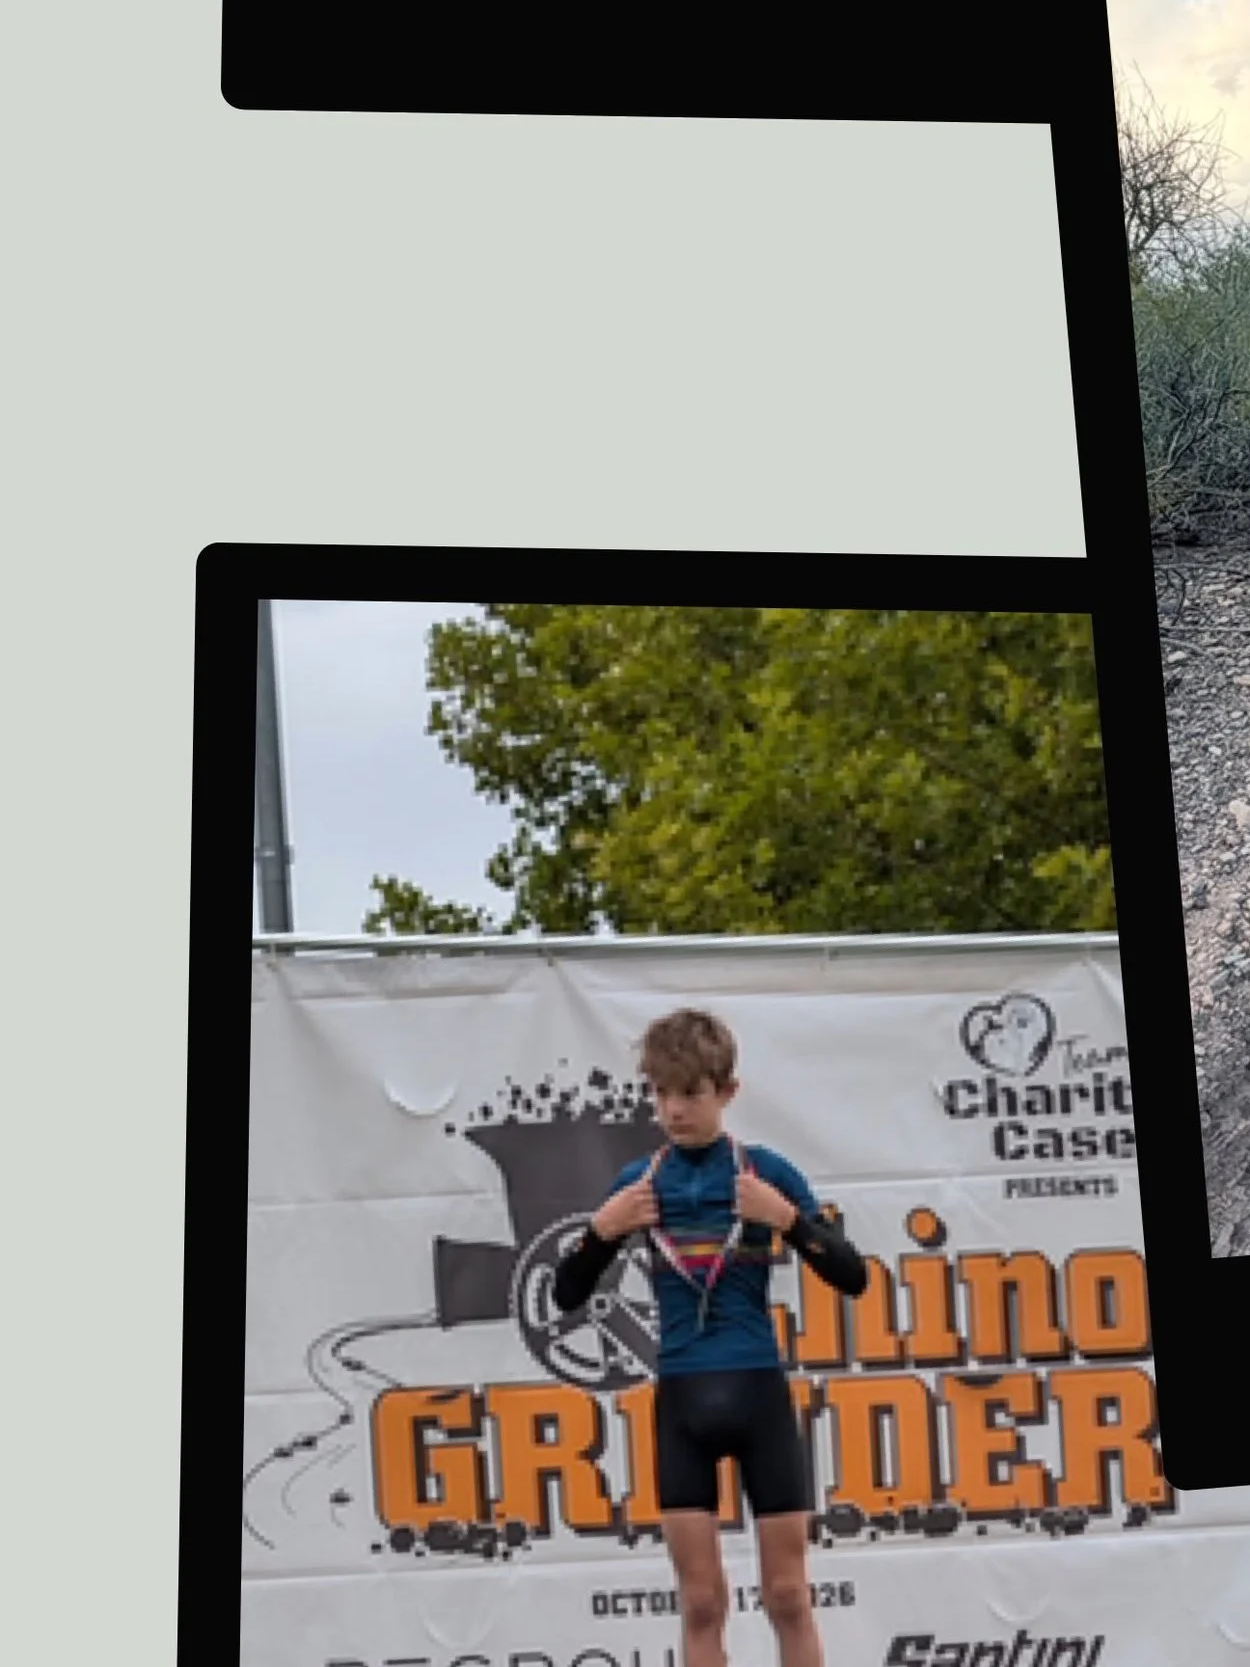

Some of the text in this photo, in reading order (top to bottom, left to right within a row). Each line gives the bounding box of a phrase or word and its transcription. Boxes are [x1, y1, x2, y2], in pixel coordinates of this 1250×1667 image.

[944, 1072, 1133, 1119] Charit
[1003, 1177, 1118, 1199] PRESENTS
[592, 1590, 680, 1616] OCTO
